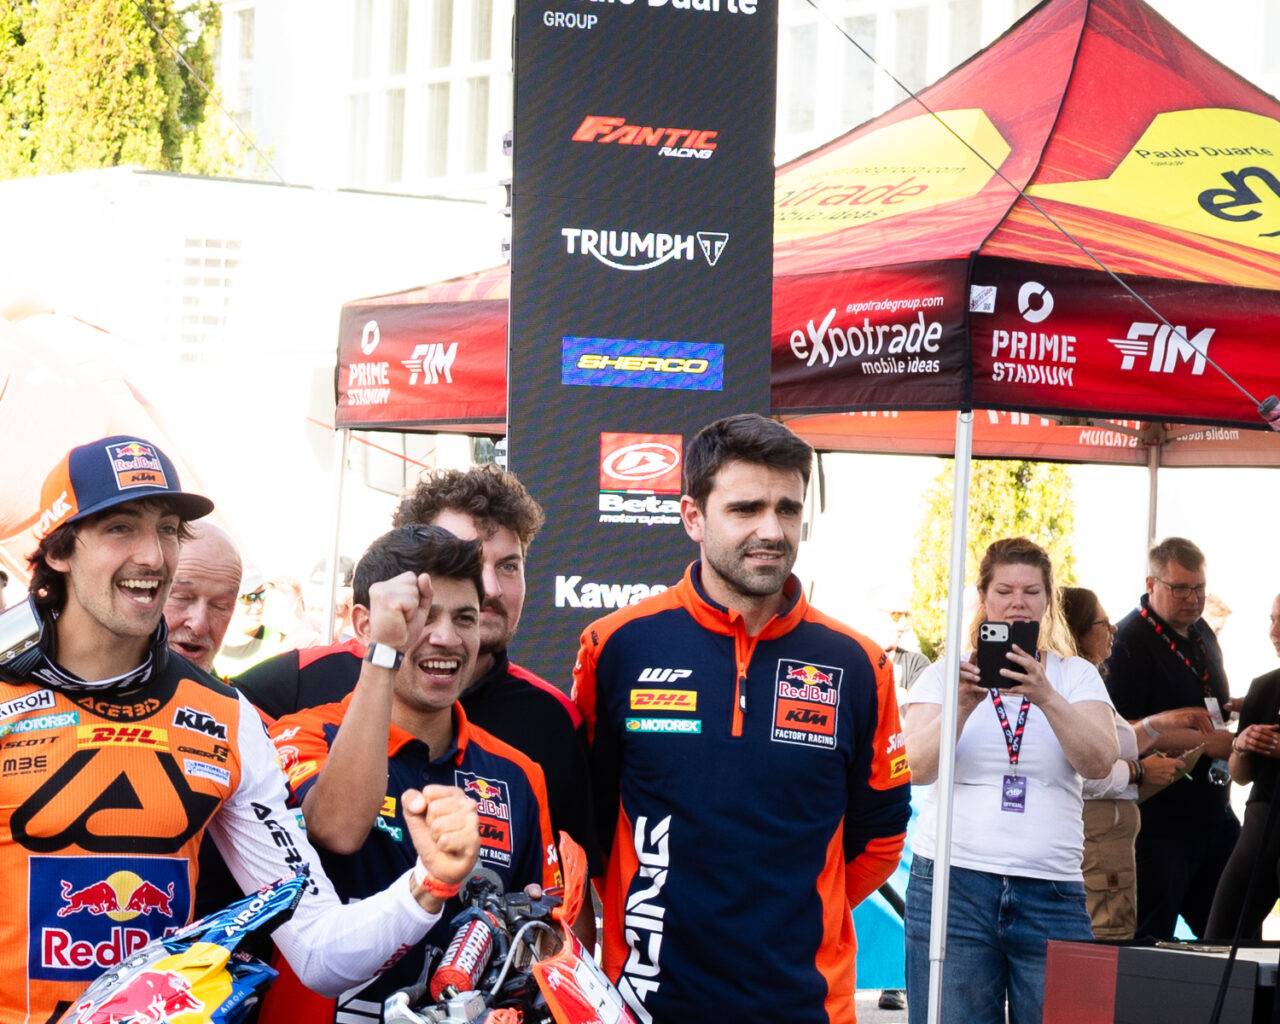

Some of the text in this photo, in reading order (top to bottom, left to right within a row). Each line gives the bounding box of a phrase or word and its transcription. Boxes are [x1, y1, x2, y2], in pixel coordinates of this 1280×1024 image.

[543, 11, 598, 29] GROUP
[572, 116, 718, 150] FANTIC
[658, 147, 713, 159] RACING
[1135, 146, 1273, 158] Paulo Duarte
[561, 228, 694, 269] TRIUMPH
[846, 296, 944, 315] expotradegroup.com
[992, 330, 1077, 363] PRIME
[1107, 322, 1216, 376] FIM
[401, 342, 458, 385] FIM
[577, 354, 709, 374] SHERCO
[862, 357, 940, 375] mobile ideas
[348, 362, 390, 386] PRIME
[992, 362, 1074, 387] STADIUM
[347, 388, 391, 406] STADIUM
[115, 457, 161, 471] Red Bull
[131, 473, 156, 482] KTM
[599, 494, 681, 513] Beta
[599, 514, 681, 526] motorcycles
[637, 667, 693, 683] WP
[634, 693, 691, 706] DHL
[779, 681, 836, 706] Red Bull
[78, 697, 160, 717] ACERBIS
[11, 712, 77, 732] MOTOREX
[174, 708, 226, 739] KTM
[641, 720, 698, 732] MOTOREX
[785, 707, 828, 727] KTM
[4, 736, 59, 749] SCOTT
[91, 728, 157, 744] DHL
[775, 729, 834, 746] FACTORY RACING
[487, 800, 508, 819] Bull
[225, 889, 276, 937] AIROH
[42, 928, 121, 969] Red
[220, 991, 245, 1013] AIROH
